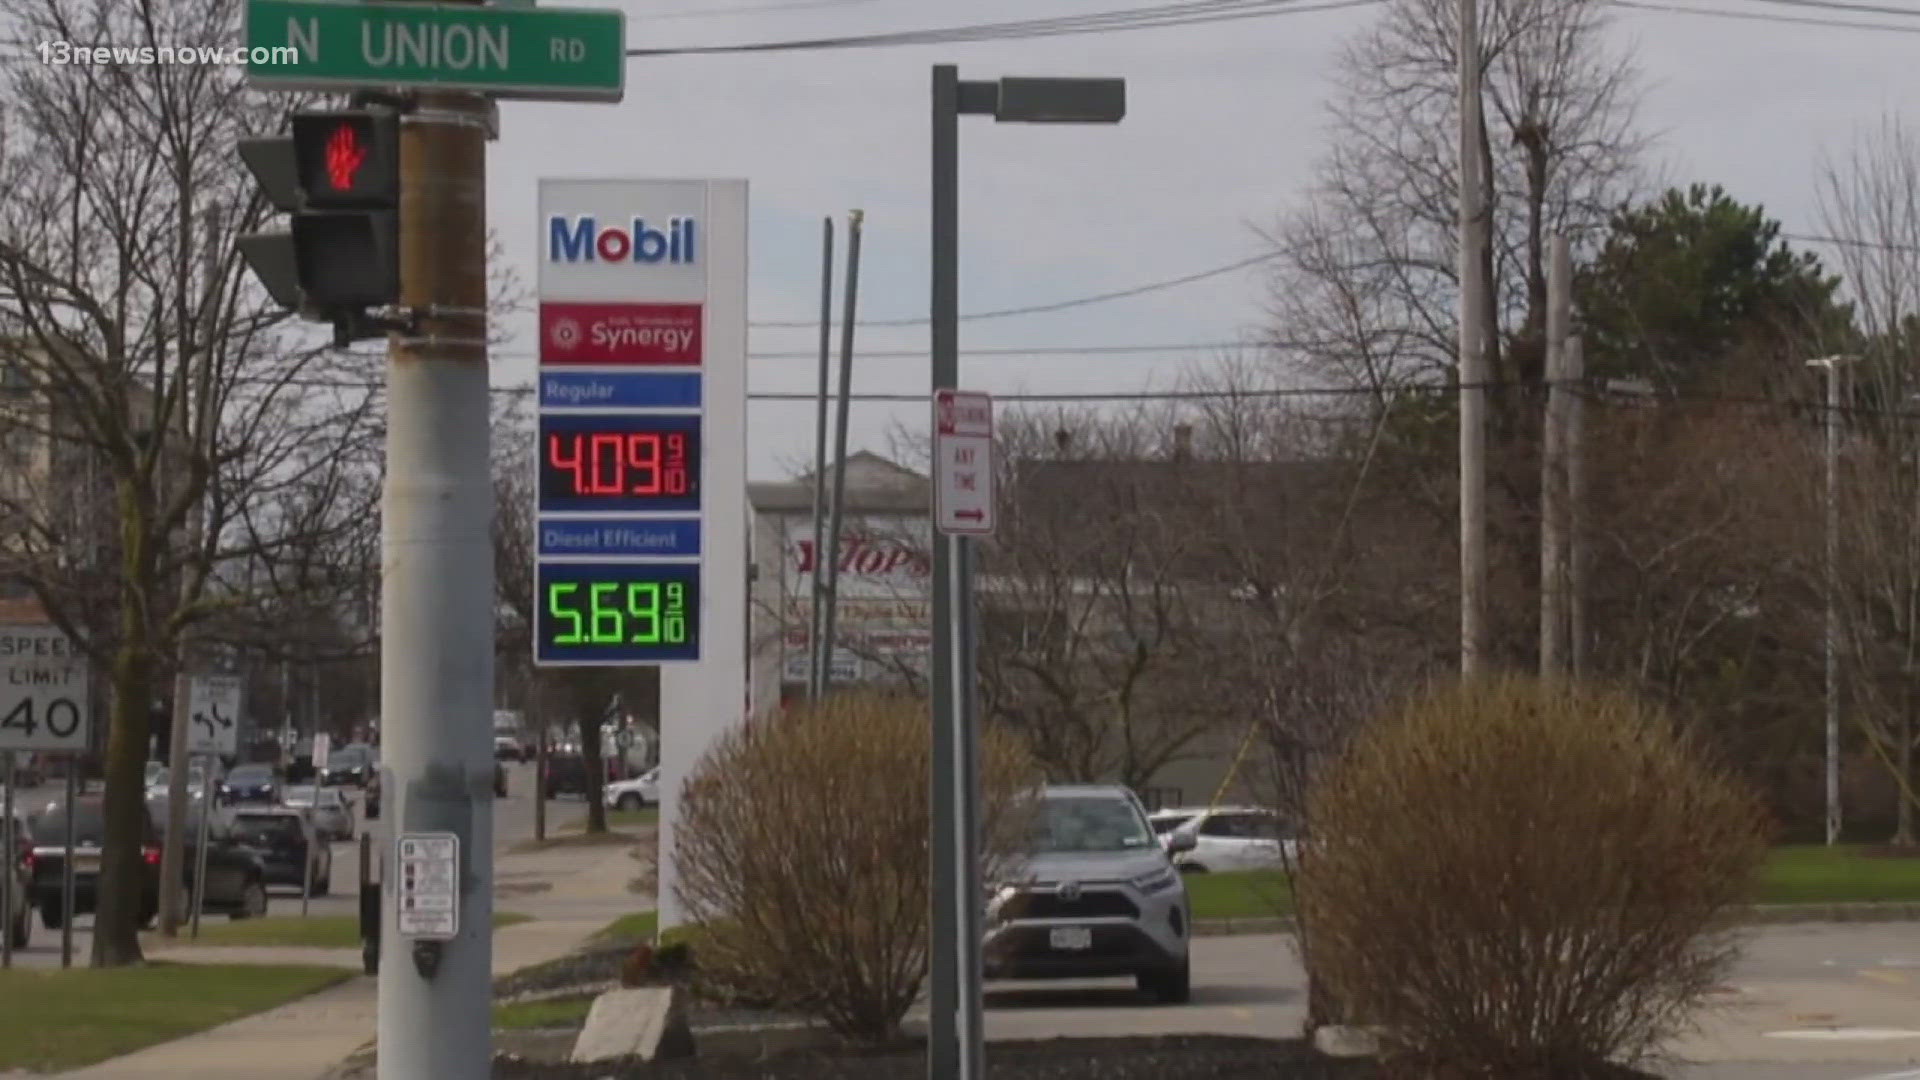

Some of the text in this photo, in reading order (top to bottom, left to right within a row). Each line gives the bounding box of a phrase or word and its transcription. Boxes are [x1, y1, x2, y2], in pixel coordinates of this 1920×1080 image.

[287, 16, 586, 70] N UNION RD
[550, 216, 695, 264] Mobil
[591, 321, 693, 352] Synergy
[546, 380, 614, 402] Regular
[550, 433, 660, 494] 4.09
[545, 528, 677, 548] Diesel Efficient
[550, 582, 660, 643] 5.69
[9, 666, 73, 685] LIMIT
[2, 697, 80, 738] 40
